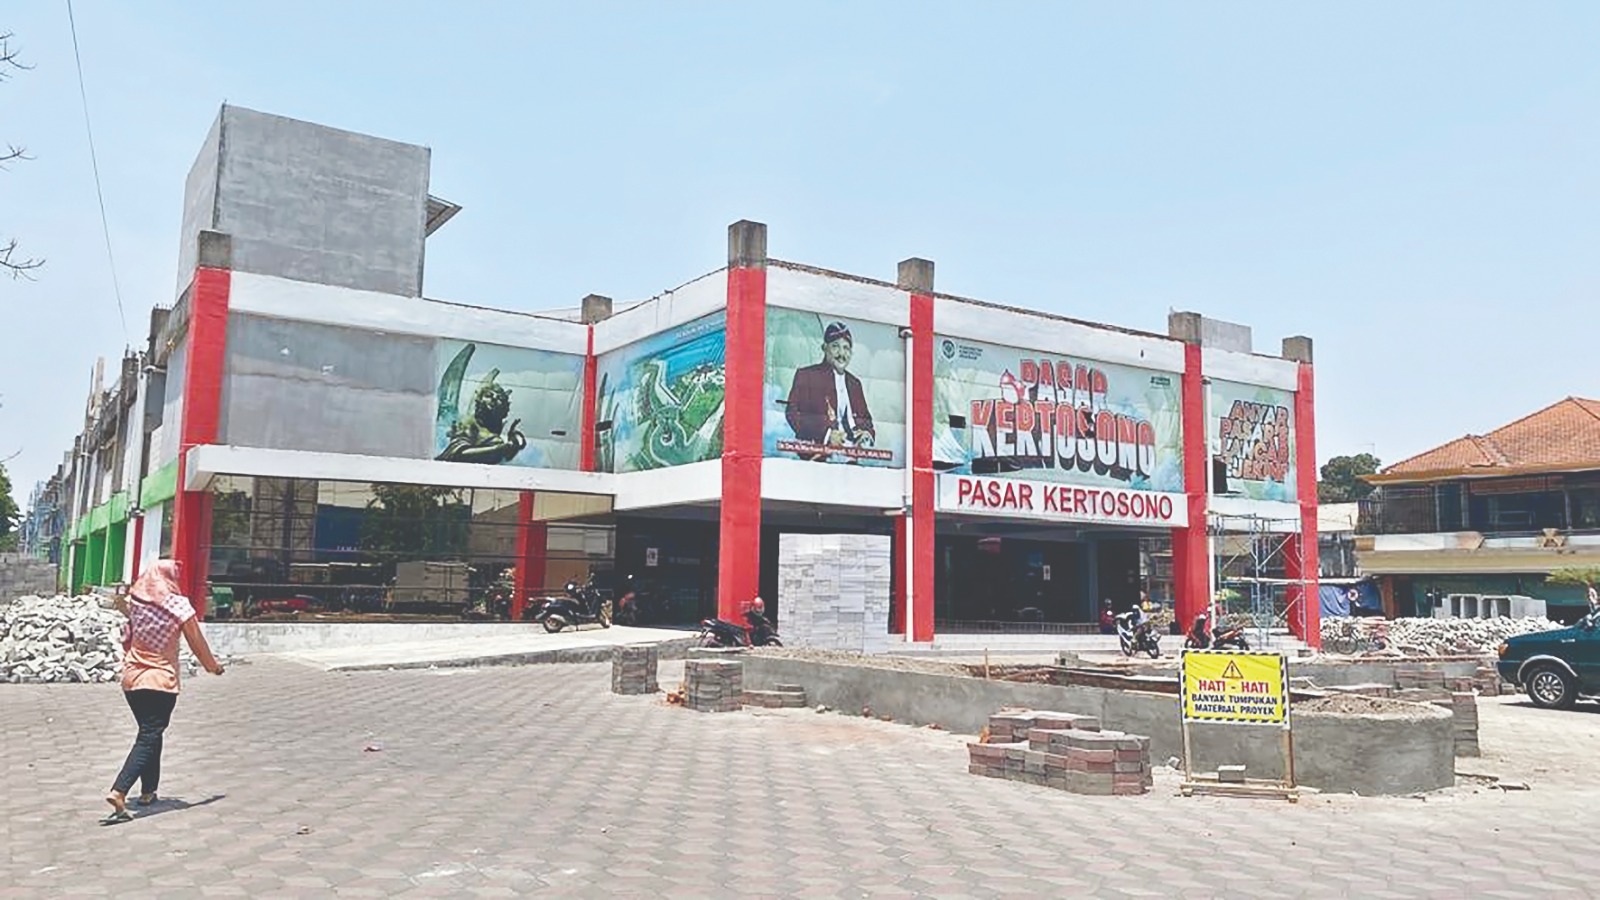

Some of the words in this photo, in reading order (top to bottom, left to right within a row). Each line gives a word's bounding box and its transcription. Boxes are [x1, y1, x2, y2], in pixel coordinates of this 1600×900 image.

[1020, 359, 1108, 411] PASAR
[1229, 400, 1288, 427] ANYAR
[971, 400, 1157, 476] KERTOSONO
[958, 479, 1034, 510] PASAR
[1043, 485, 1173, 520] KERTOSONO
[1191, 693, 1226, 703] BANYAK
[1228, 695, 1278, 705] TUMPUKAN
[1199, 680, 1226, 692] HATI
[1241, 681, 1269, 693] HATI
[1194, 703, 1237, 713] MATERIAL
[1240, 705, 1275, 715] PROYEK
